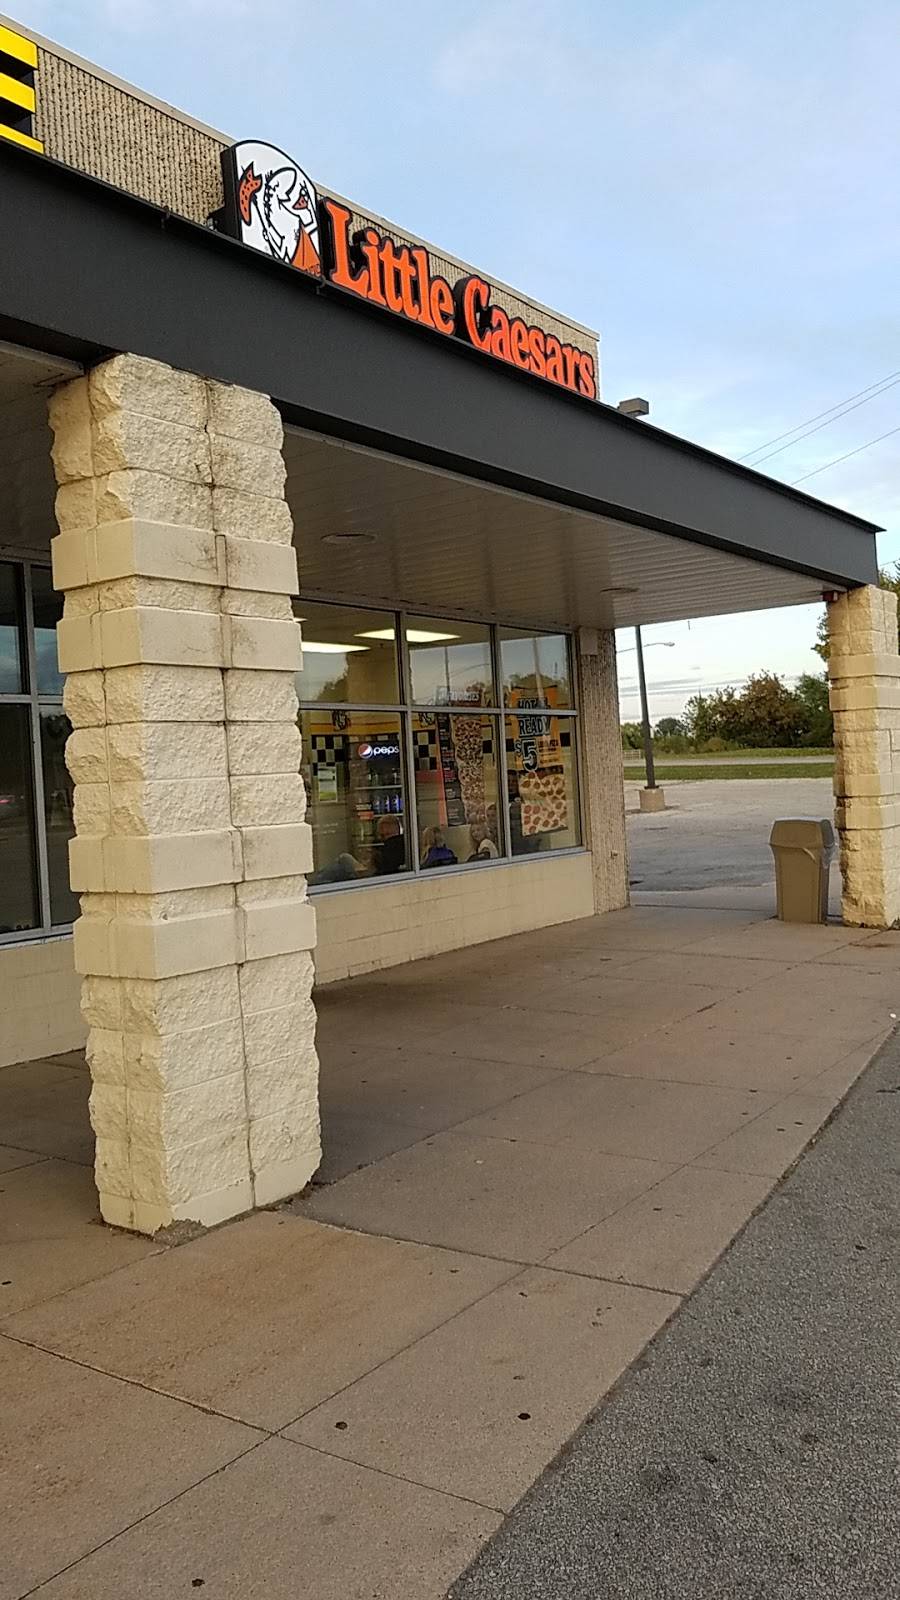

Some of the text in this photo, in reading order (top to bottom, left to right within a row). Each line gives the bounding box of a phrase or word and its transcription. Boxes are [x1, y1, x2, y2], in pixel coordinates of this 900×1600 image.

[324, 199, 597, 401] Little Caesars
[518, 716, 551, 737] READY
[373, 745, 400, 757] peps
